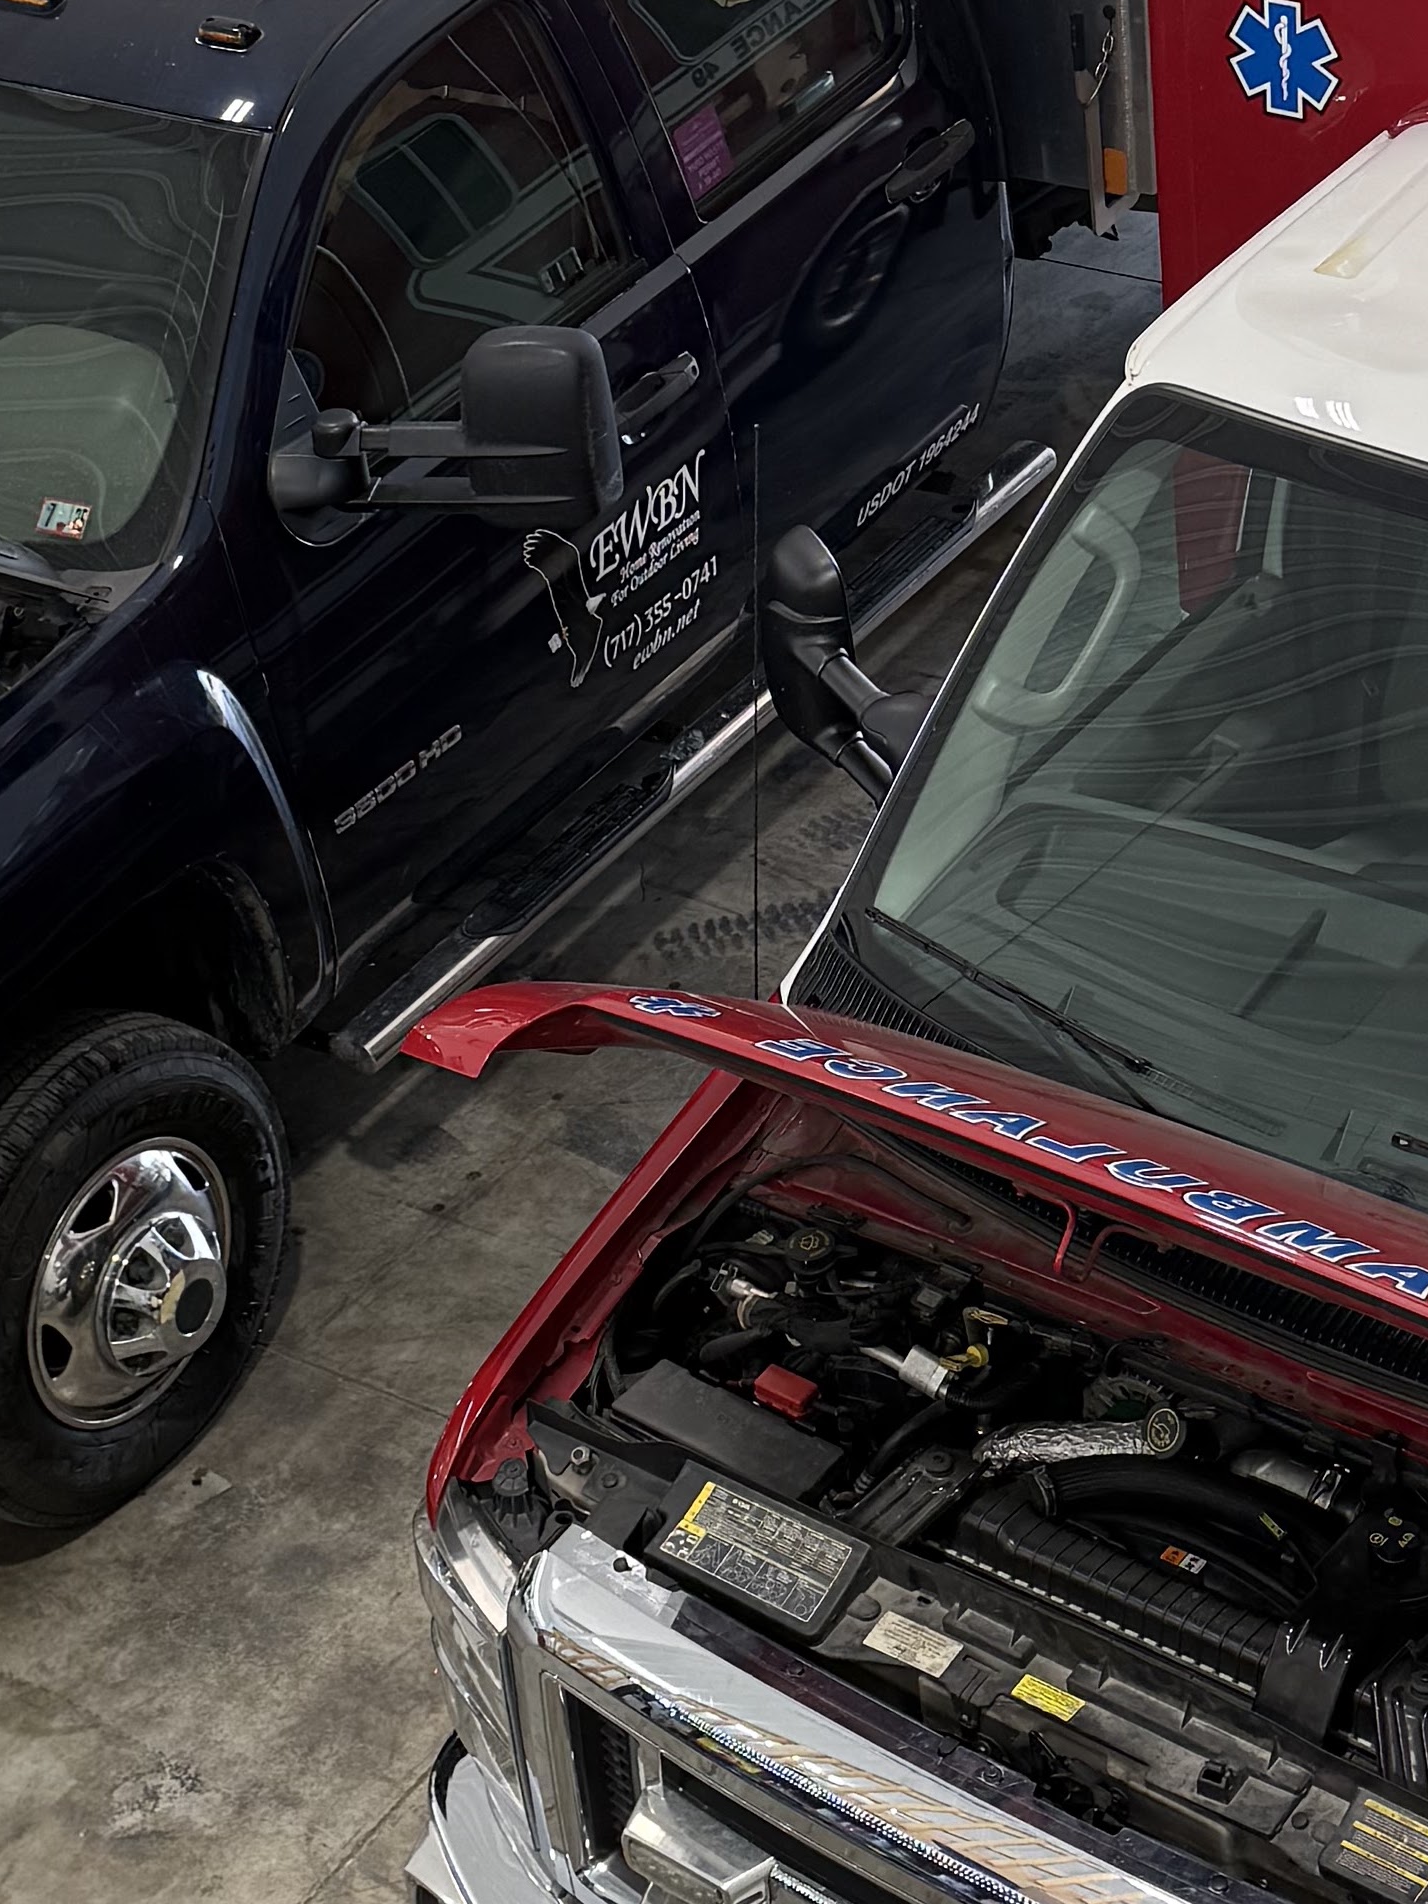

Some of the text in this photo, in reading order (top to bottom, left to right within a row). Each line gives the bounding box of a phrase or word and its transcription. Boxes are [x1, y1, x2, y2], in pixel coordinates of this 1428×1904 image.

[589, 448, 706, 583] EWBN
[857, 459, 917, 527] USDOT
[610, 527, 700, 608] For Outdoor Living
[619, 509, 701, 584] Home Renovation
[604, 555, 718, 668] (717) 355-0741
[632, 598, 701, 670] ewbn.net
[334, 724, 462, 834] 3500 HD
